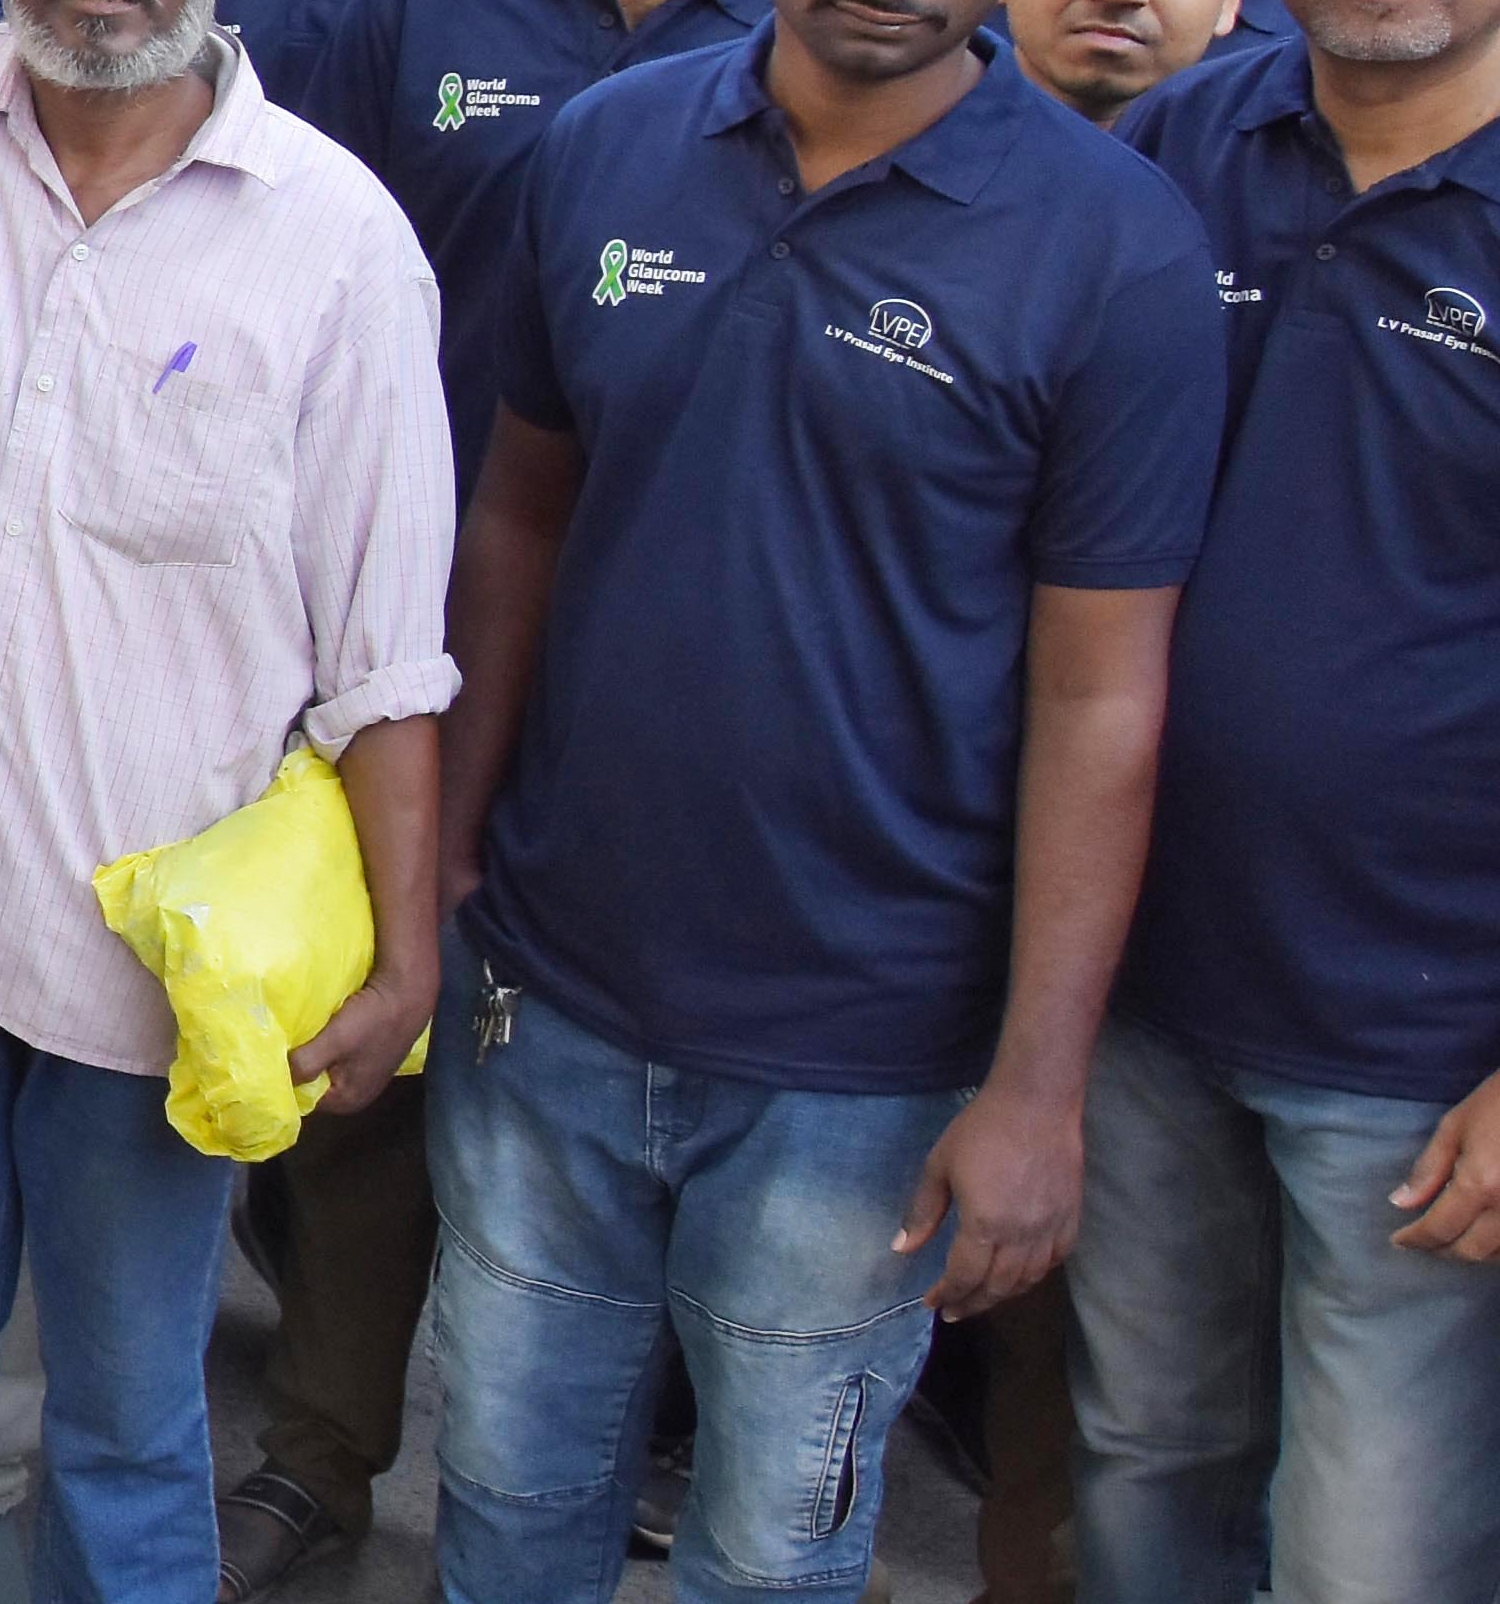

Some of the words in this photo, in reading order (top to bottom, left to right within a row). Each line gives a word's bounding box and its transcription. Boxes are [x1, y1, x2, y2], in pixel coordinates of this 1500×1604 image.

[467, 79, 507, 91] World
[467, 91, 540, 106] Glaucoma
[465, 104, 500, 117] Week
[631, 248, 674, 265] World
[628, 263, 706, 283] Glaucoma
[627, 279, 665, 296] Week
[870, 308, 929, 348] LVPEI
[1376, 316, 1388, 328] L
[1388, 319, 1400, 331] V
[1400, 322, 1443, 342] Prasad
[1444, 334, 1468, 351] Eye
[825, 324, 834, 336] L
[834, 327, 843, 338] V
[843, 331, 883, 355] Prasad
[883, 347, 905, 363] Eye
[906, 355, 954, 384] Institute
